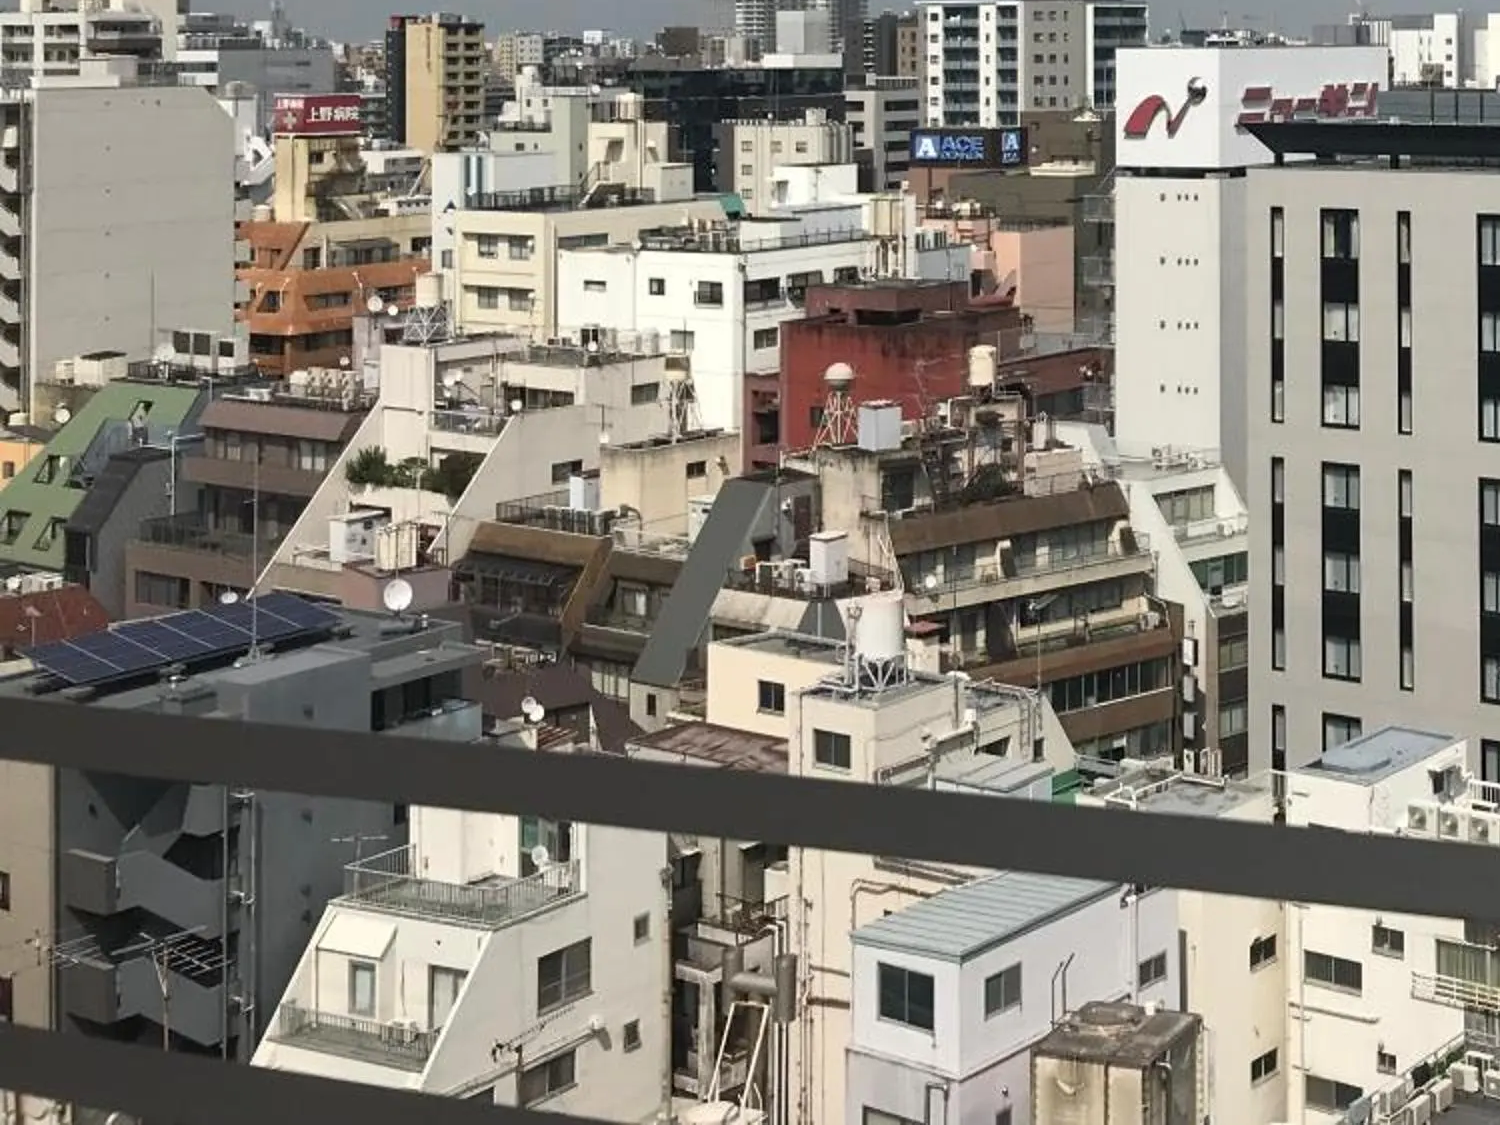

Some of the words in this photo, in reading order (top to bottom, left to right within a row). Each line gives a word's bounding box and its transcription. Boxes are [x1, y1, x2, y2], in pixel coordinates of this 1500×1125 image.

[306, 106, 360, 123] 上野病院
[941, 136, 984, 151] ACE
